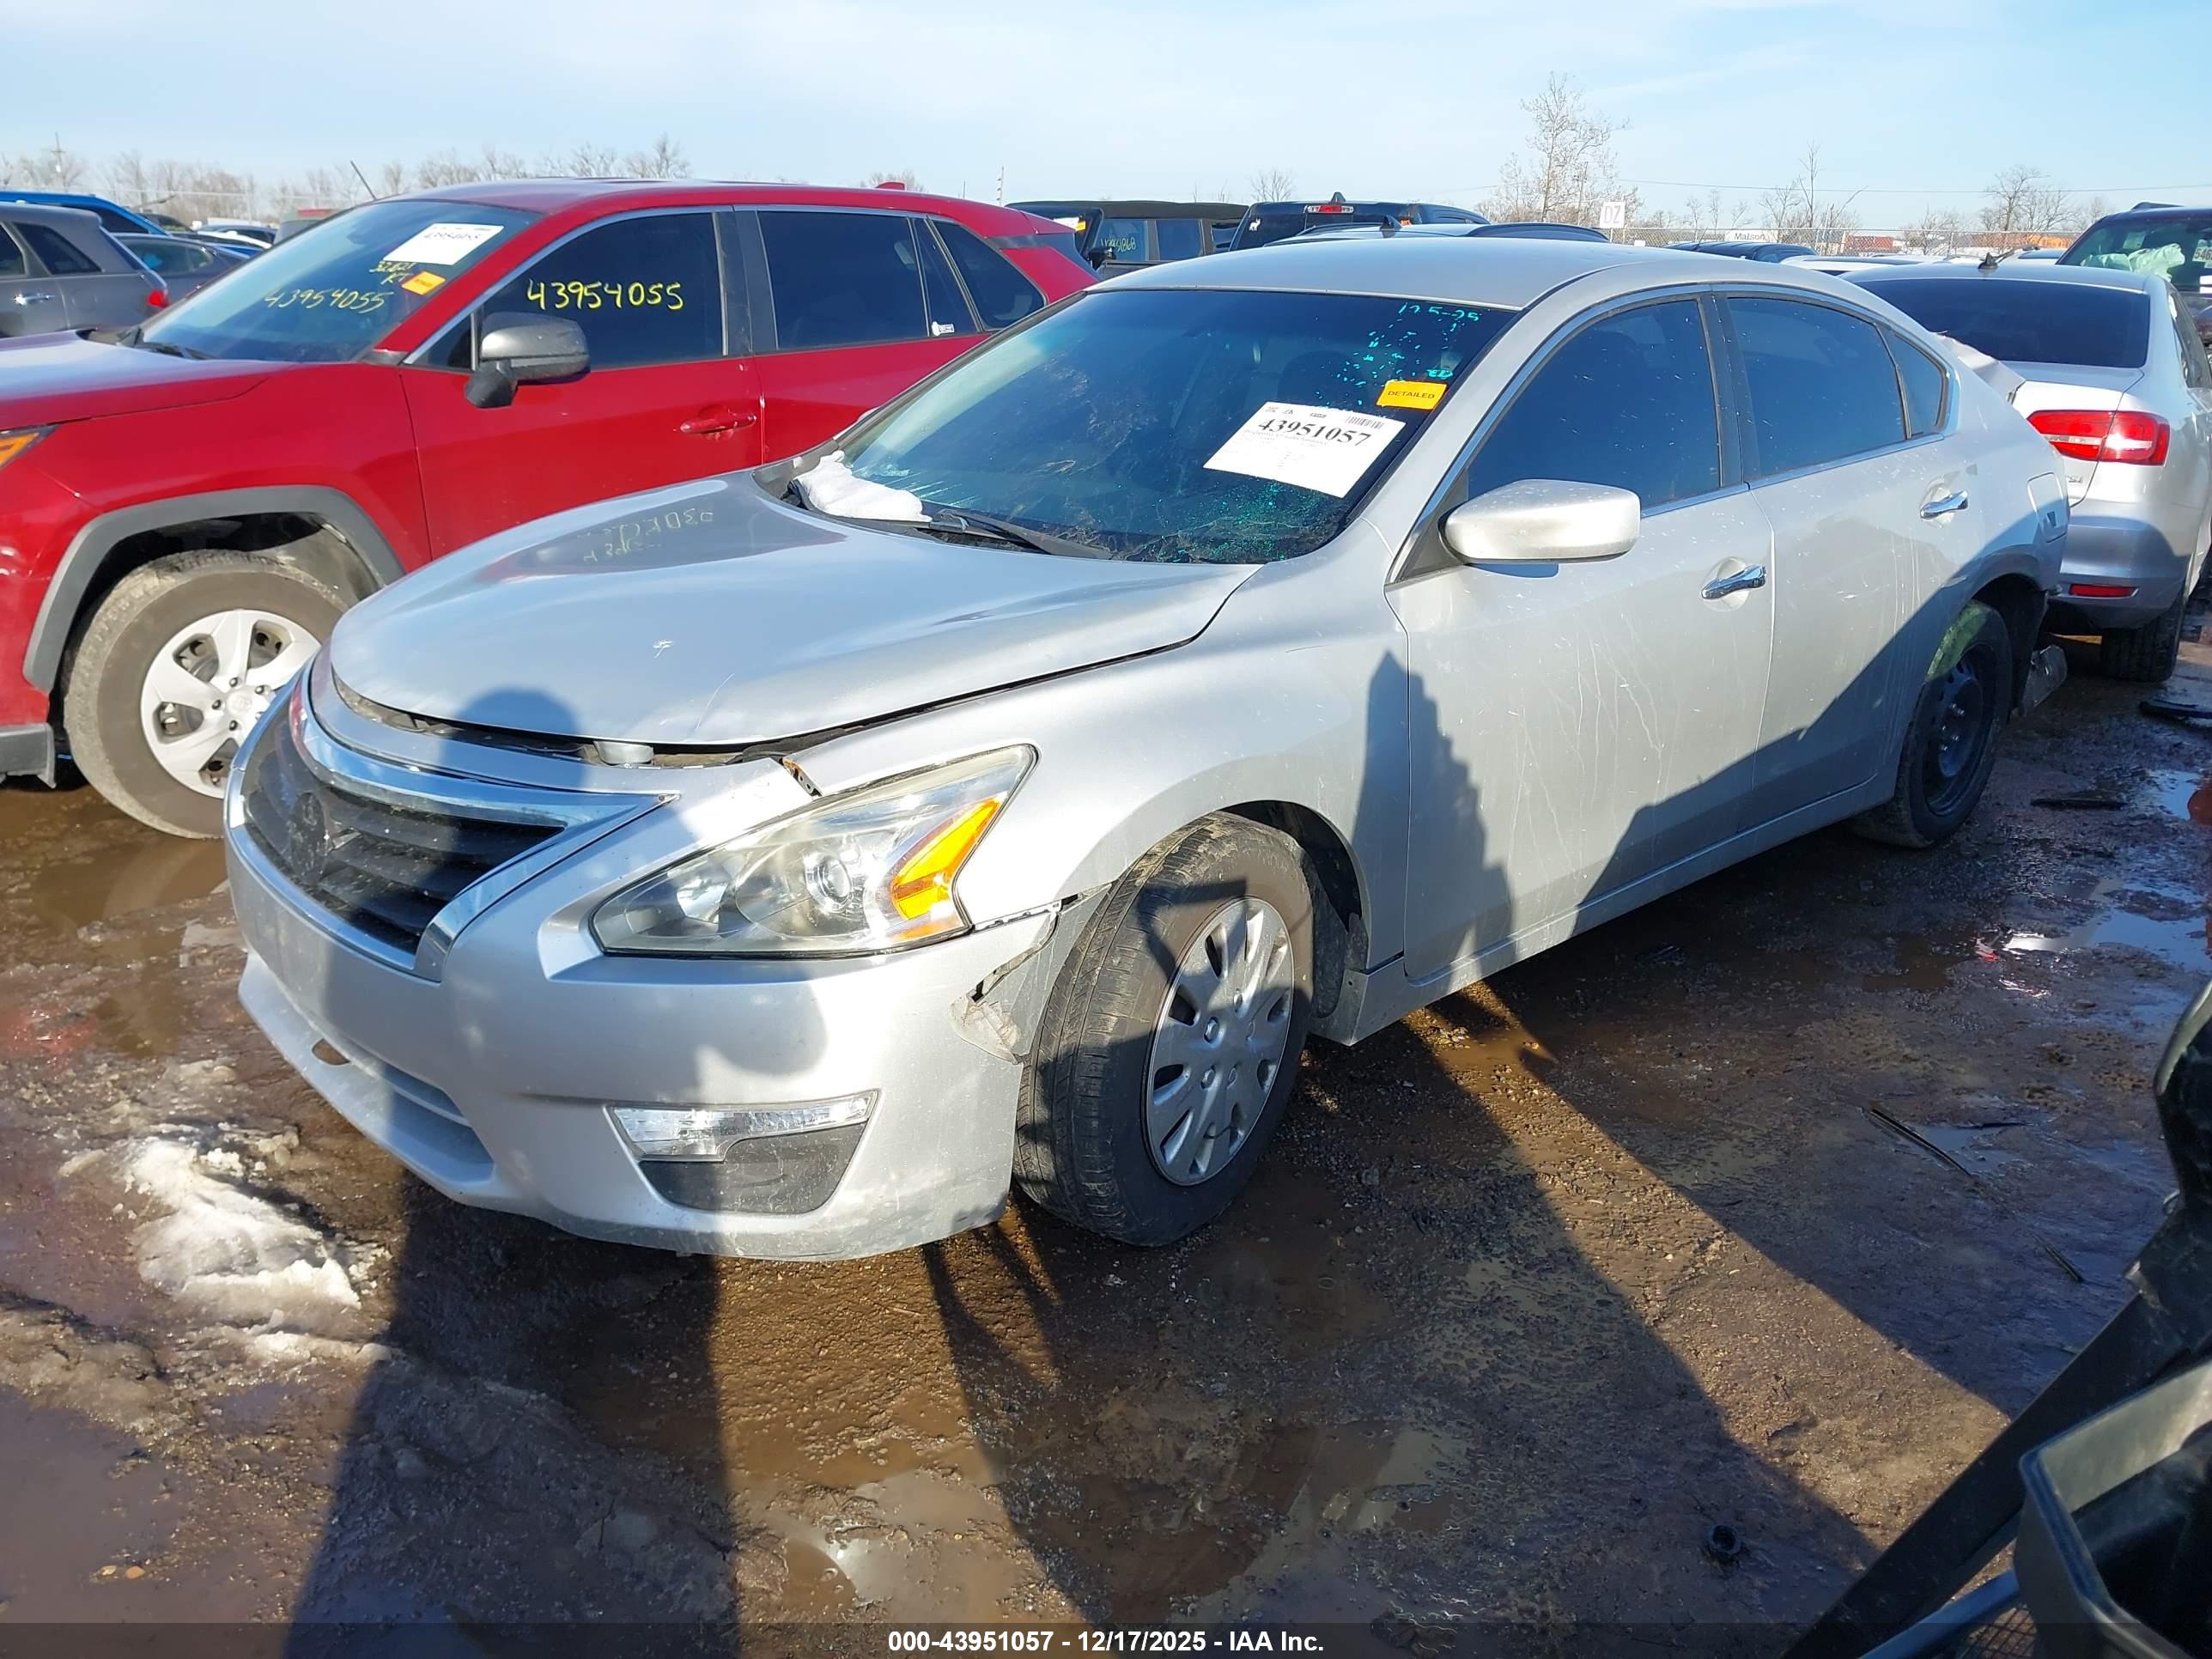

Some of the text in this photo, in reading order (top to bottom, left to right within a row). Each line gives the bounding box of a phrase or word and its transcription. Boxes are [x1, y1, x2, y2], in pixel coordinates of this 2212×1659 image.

[264, 288, 395, 313] 43954055
[526, 278, 684, 311] 43954055
[1387, 389, 1436, 400] DETAILED
[1258, 418, 1372, 447] 43951057
